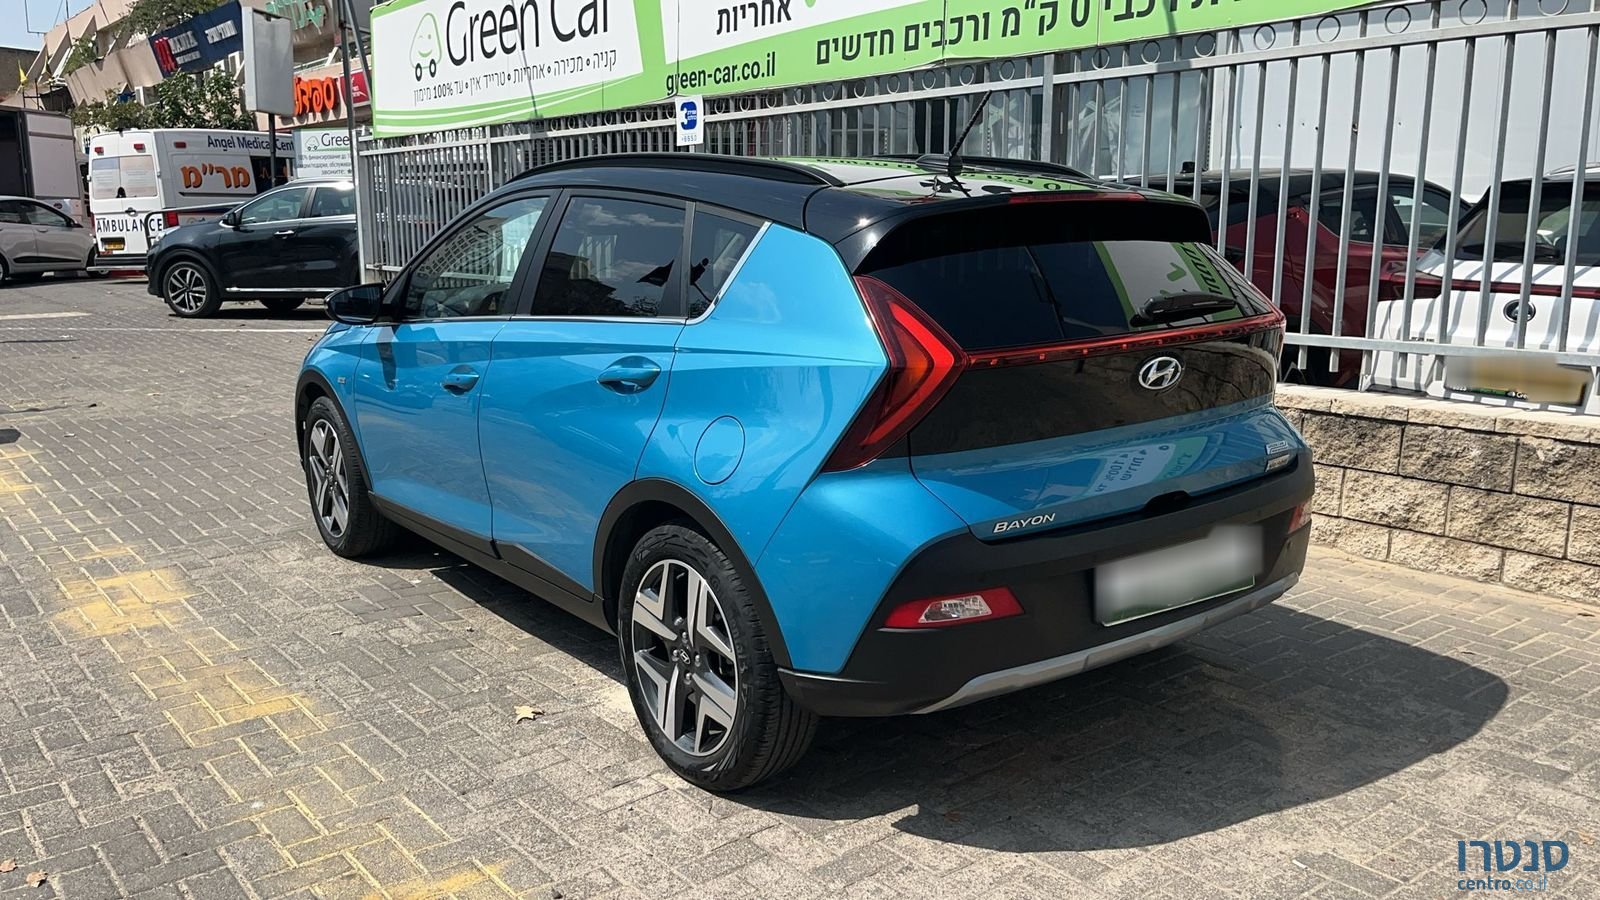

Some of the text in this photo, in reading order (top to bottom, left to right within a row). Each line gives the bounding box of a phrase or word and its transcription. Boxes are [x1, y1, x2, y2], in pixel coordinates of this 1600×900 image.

[446, 0, 540, 67] Green
[716, 0, 792, 35] אחריות
[903, 11, 991, 52] ורכבים
[816, 28, 895, 65] חדשים
[413, 49, 617, 107] קניה מכירה אחריות טרייד אין עד 100% מימון
[666, 51, 776, 96] green-car.co.il
[207, 134, 236, 151] Angel
[236, 136, 271, 150] Medica
[321, 133, 350, 147] Gree
[96, 218, 163, 233] AMBULANCE
[993, 512, 1056, 533] BAYON
